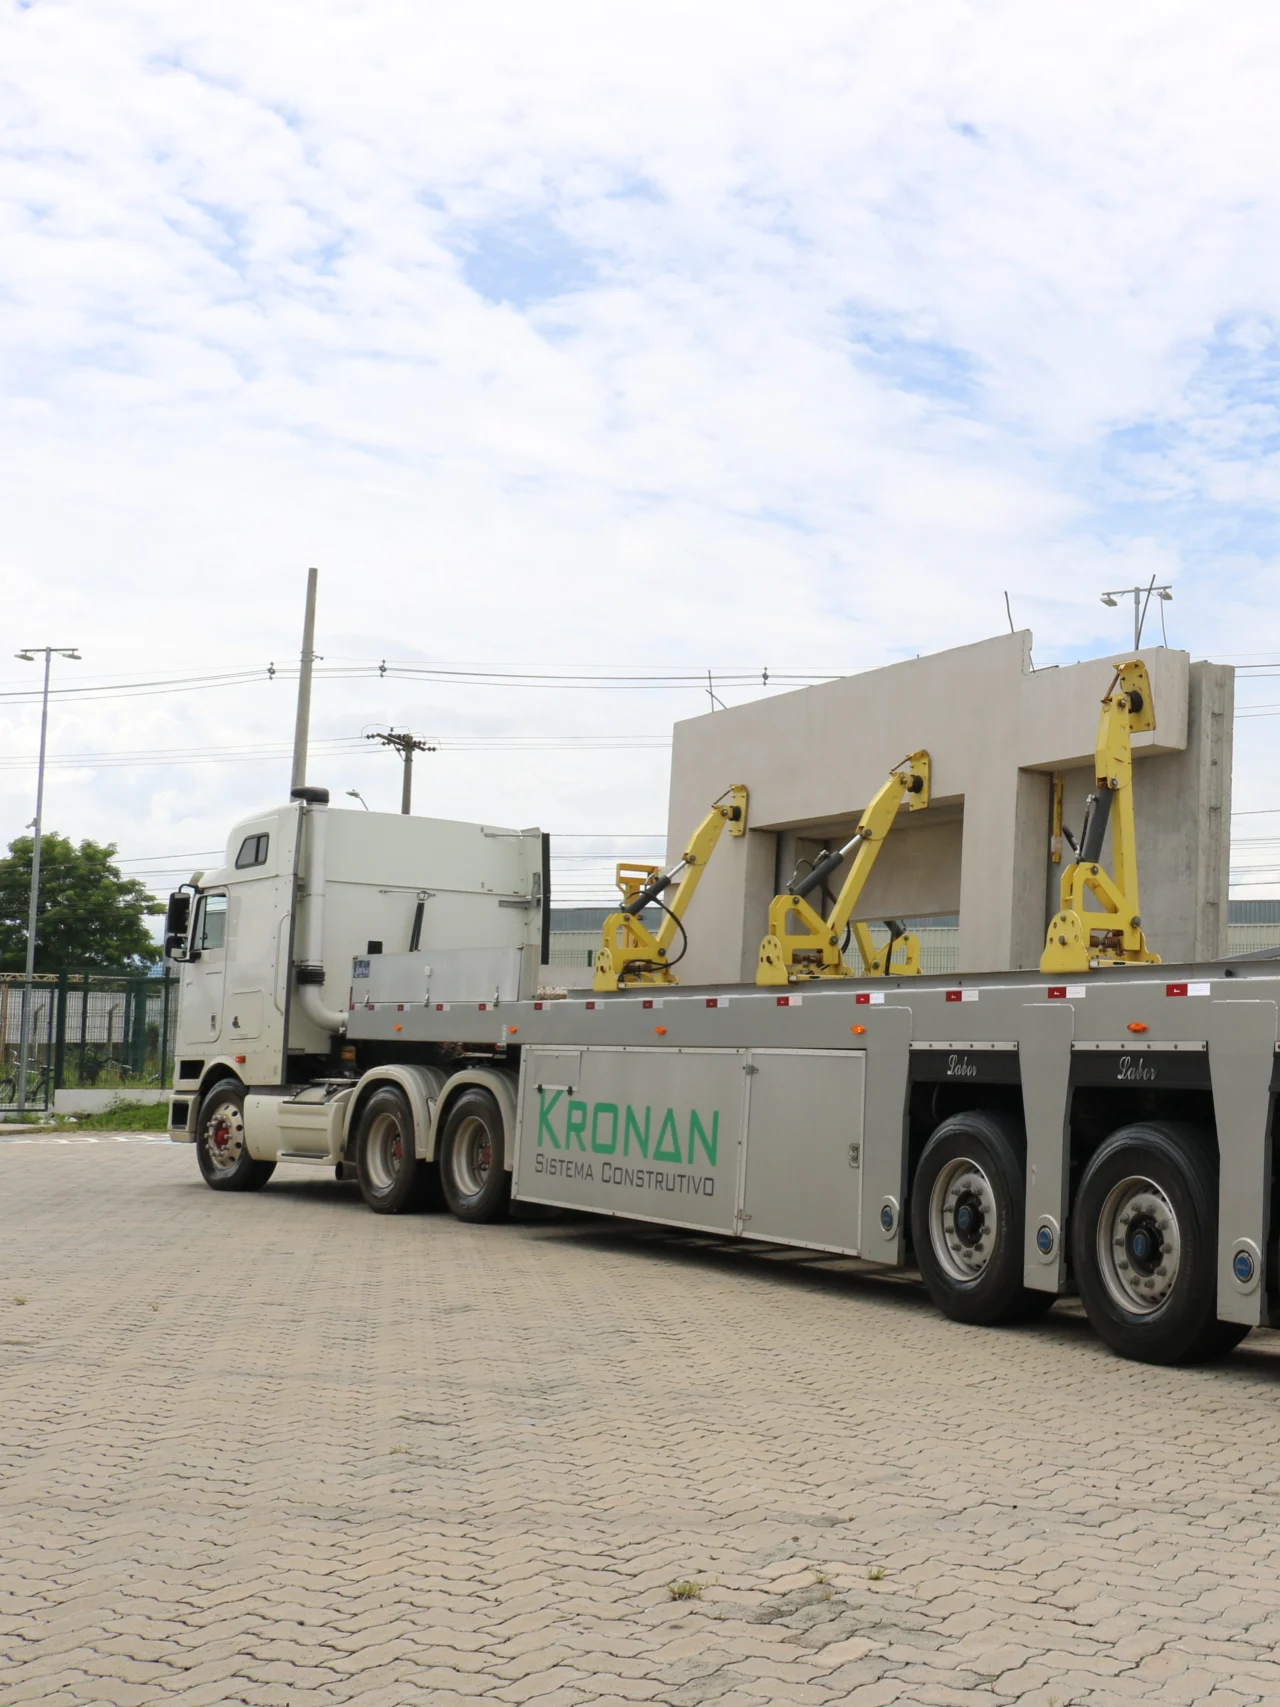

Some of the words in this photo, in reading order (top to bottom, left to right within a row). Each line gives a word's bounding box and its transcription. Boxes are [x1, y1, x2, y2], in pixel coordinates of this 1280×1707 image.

[947, 1054, 977, 1077] Labor
[1117, 1056, 1158, 1080] Labor
[537, 1089, 720, 1167] KRONAN
[534, 1153, 594, 1182] SISTEMA
[601, 1162, 715, 1197] CONSTRUTIVO
